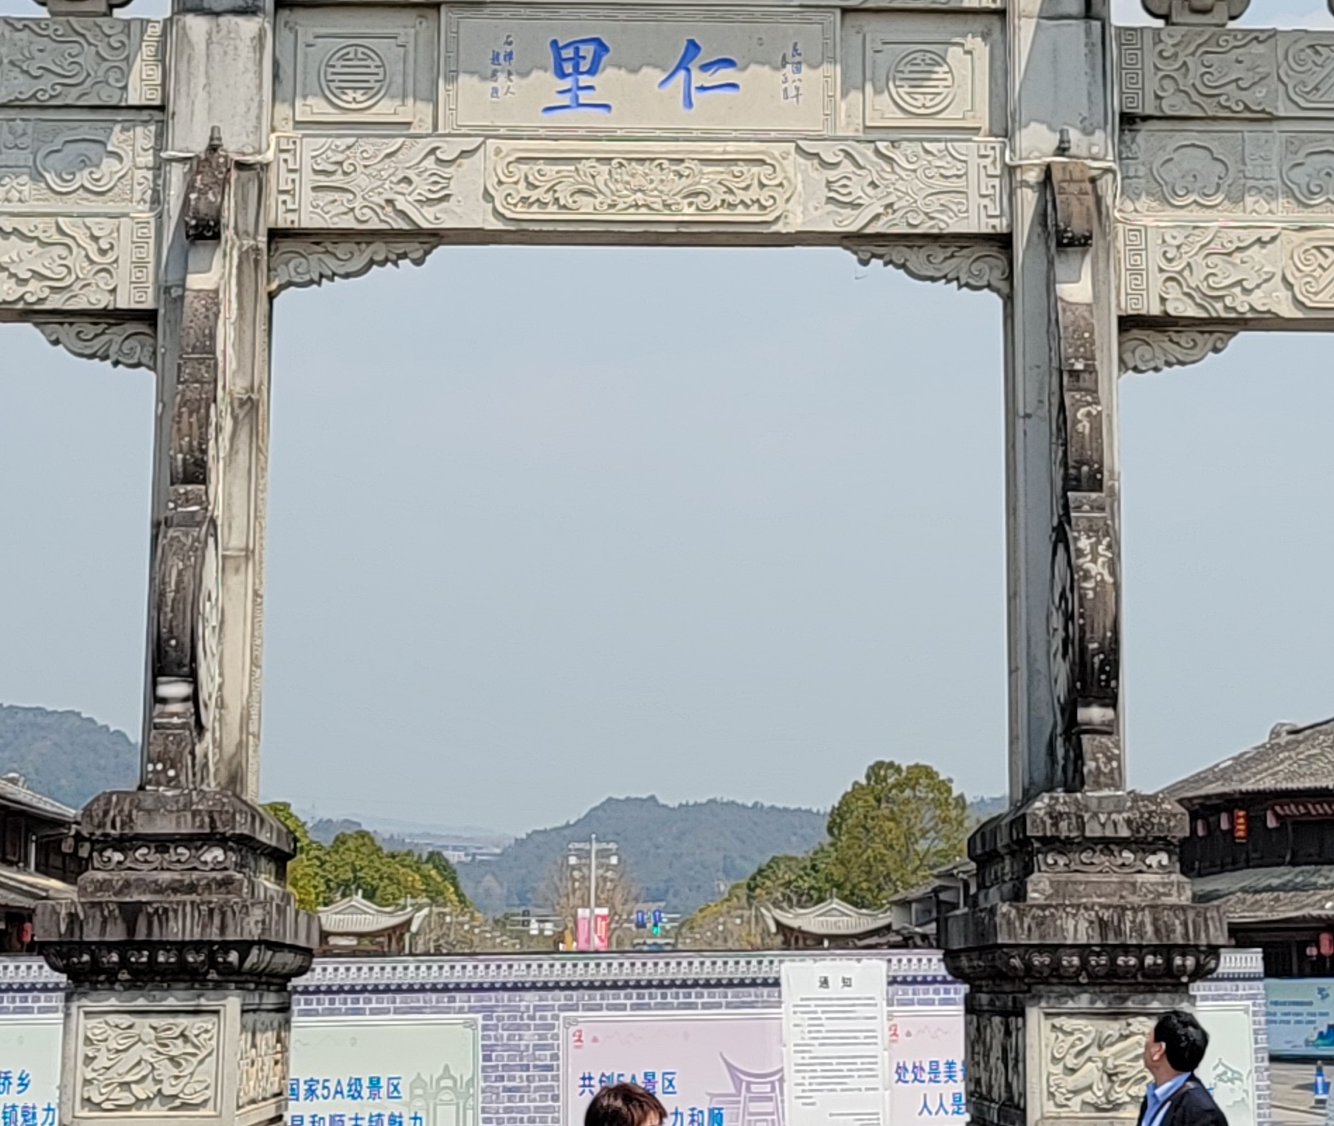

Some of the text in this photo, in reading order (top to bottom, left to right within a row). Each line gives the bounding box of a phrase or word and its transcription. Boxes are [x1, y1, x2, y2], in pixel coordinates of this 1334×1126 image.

[541, 37, 741, 114] 仁里
[287, 1076, 402, 1102] 国家5A级景区
